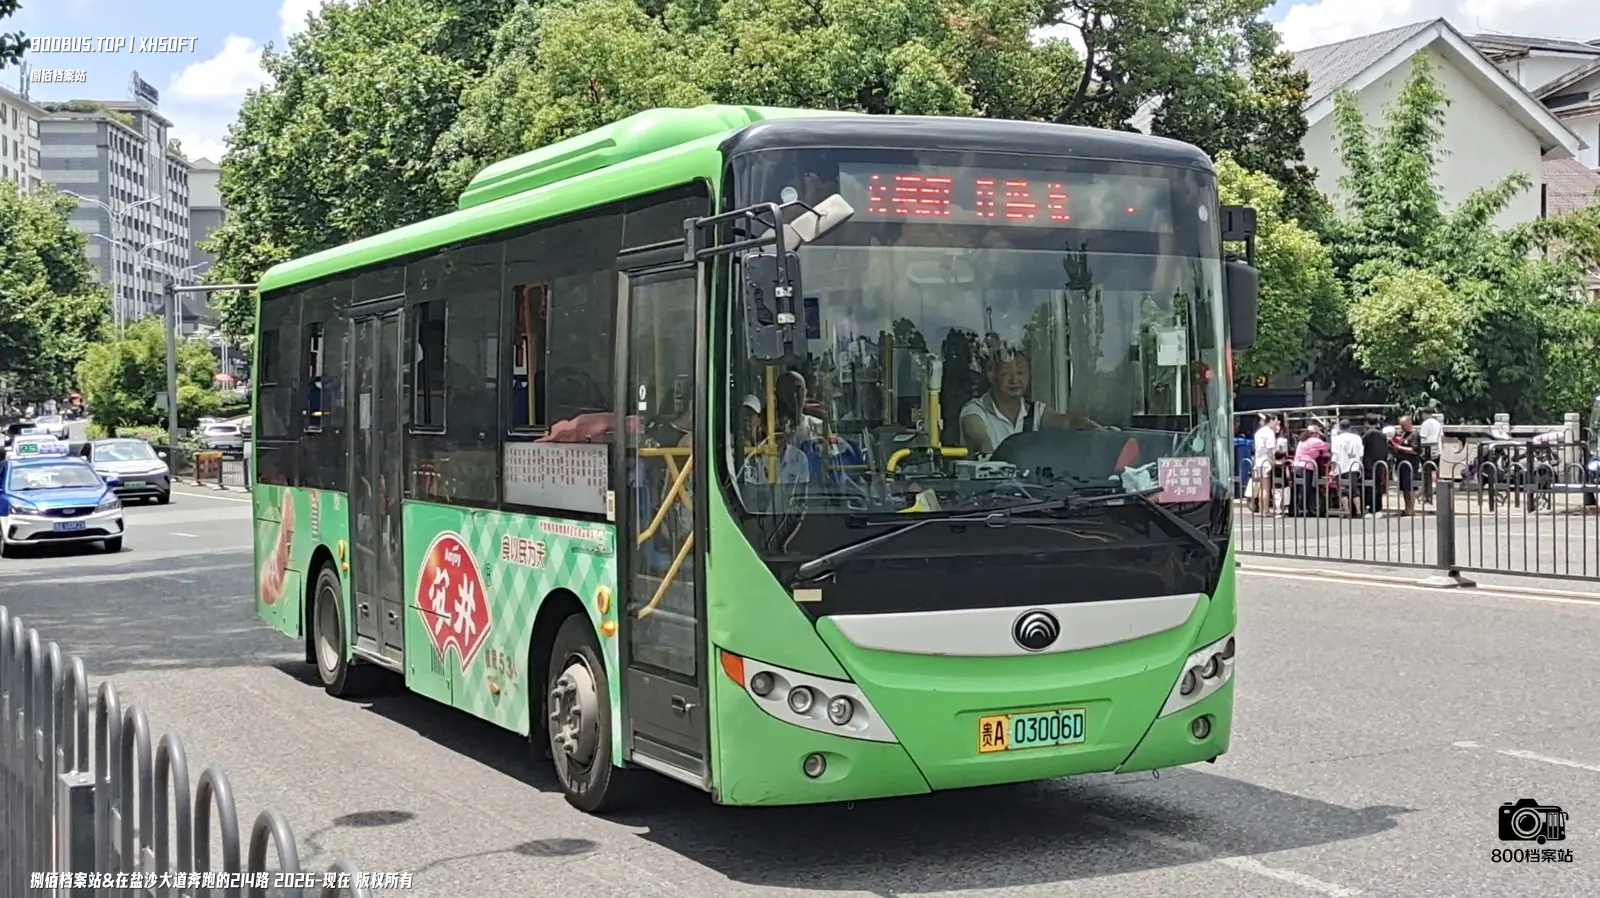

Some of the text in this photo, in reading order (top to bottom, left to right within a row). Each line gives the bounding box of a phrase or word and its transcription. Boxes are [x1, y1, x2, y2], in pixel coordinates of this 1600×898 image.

[502, 536, 546, 569] 食以民为天
[429, 567, 476, 646] 安井
